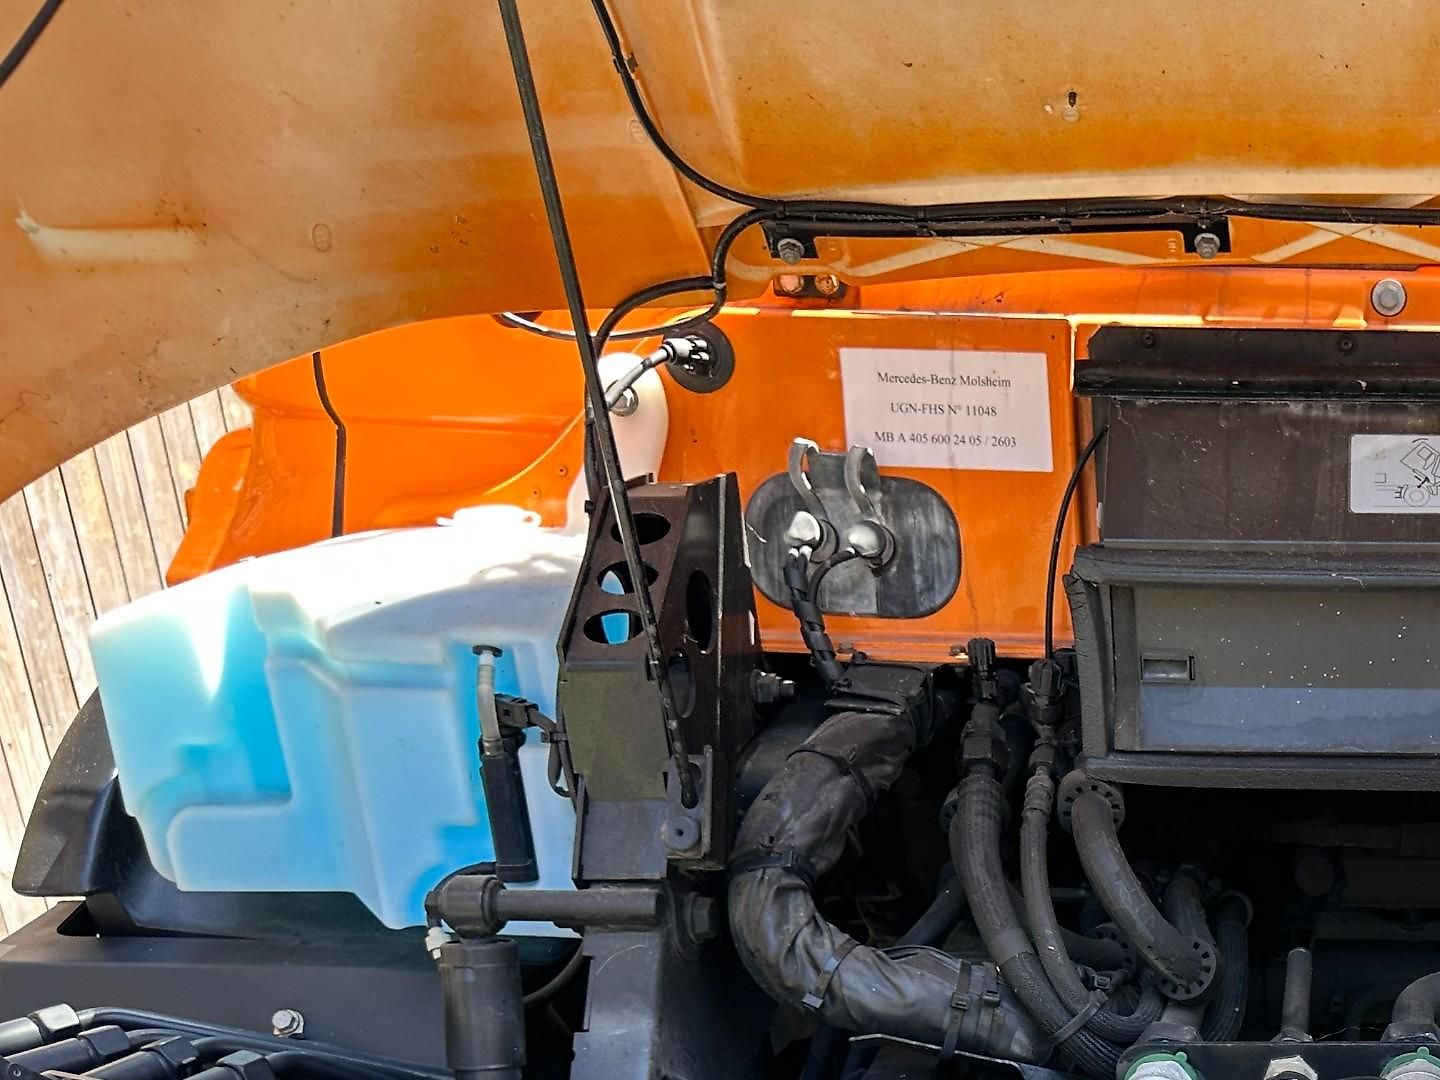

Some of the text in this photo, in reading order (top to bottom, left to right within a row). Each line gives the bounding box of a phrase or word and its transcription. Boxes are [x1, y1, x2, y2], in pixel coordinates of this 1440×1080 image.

[878, 372, 1011, 388] Mercedes-Benz Molsheim
[890, 402, 945, 416] UGN-FHS
[965, 404, 997, 417] 11048
[874, 431, 895, 443] MB
[896, 432, 907, 444] A
[909, 432, 929, 445] 405
[931, 433, 950, 445] 600
[953, 434, 966, 446] 24
[968, 434, 982, 446] 05
[991, 434, 1017, 448] 2603
